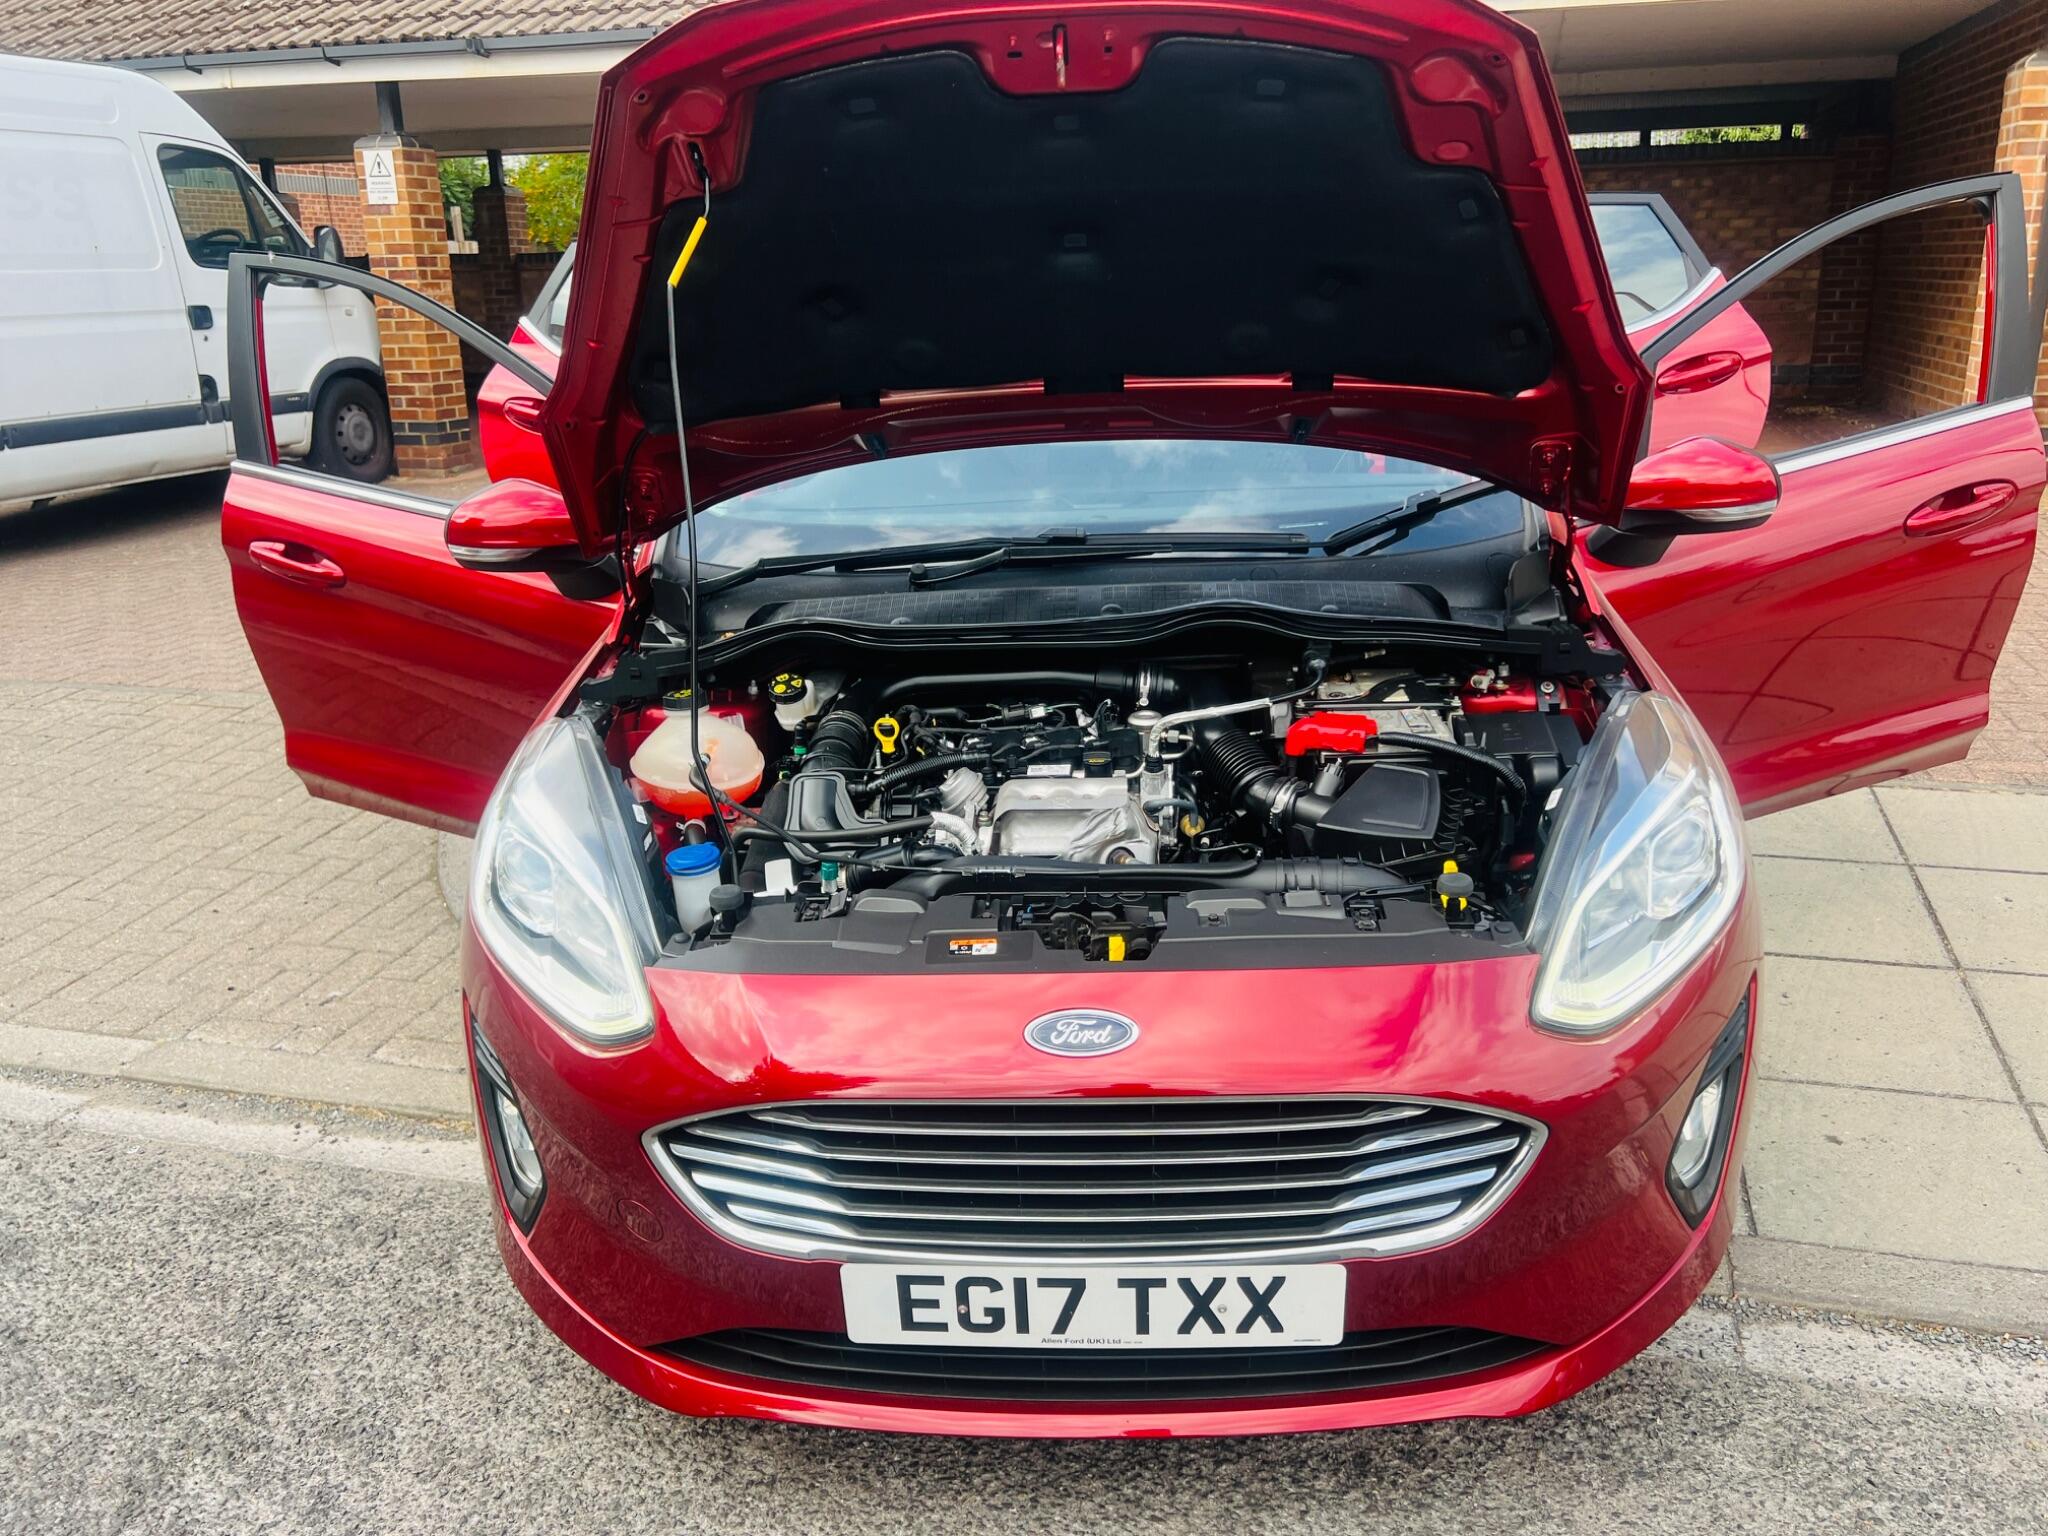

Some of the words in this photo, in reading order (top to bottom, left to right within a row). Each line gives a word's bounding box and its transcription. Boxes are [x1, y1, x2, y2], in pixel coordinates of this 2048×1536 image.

[1050, 1019, 1113, 1045] Ford
[896, 1274, 1087, 1335] EG17
[1117, 1275, 1286, 1336] TXX
[1086, 1337, 1105, 1345] (UK)
